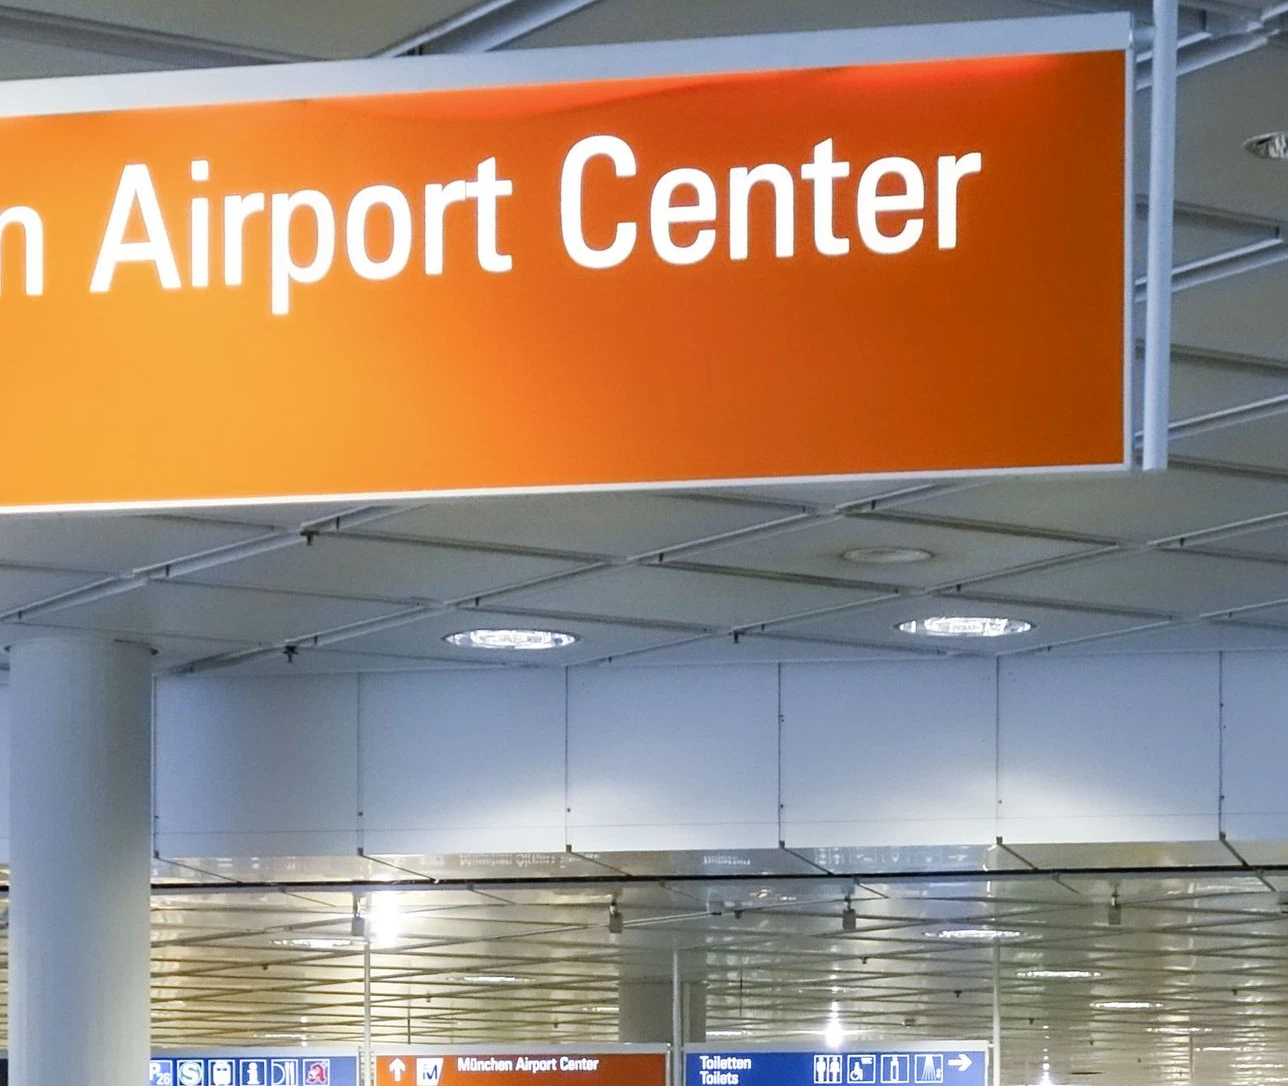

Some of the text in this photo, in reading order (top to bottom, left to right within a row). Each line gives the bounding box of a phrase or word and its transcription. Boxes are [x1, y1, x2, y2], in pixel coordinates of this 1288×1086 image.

[90, 157, 513, 315] Airport
[560, 134, 982, 269] Center
[457, 1056, 599, 1073] München Airport Center
[700, 1055, 752, 1070] Toiletten
[700, 1071, 739, 1085] Toilets
